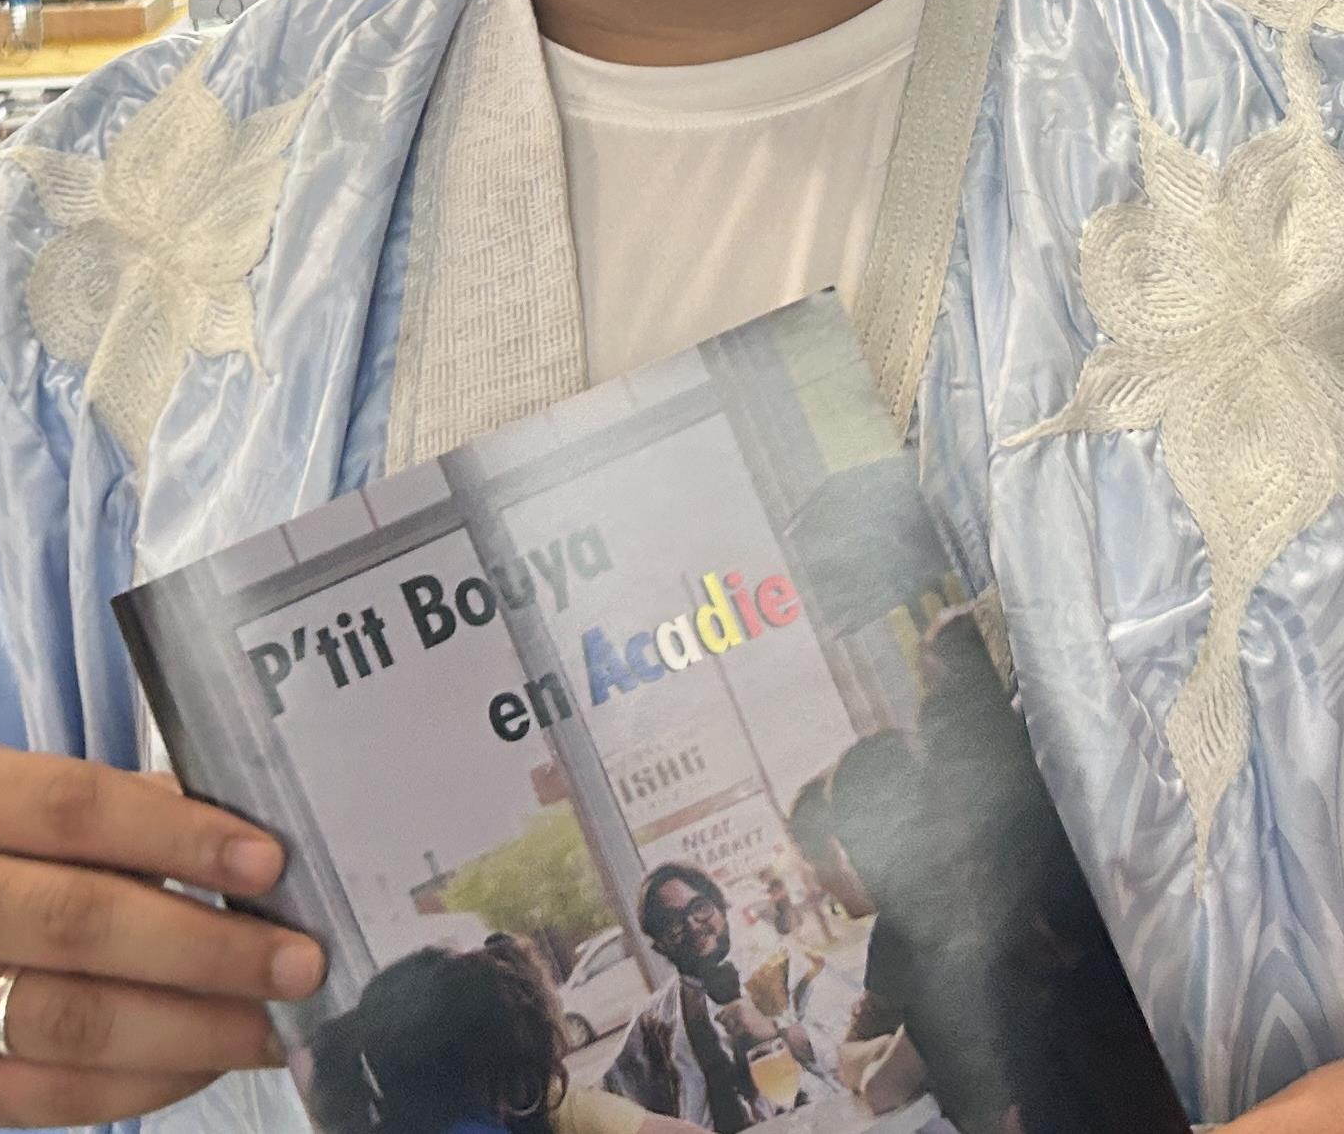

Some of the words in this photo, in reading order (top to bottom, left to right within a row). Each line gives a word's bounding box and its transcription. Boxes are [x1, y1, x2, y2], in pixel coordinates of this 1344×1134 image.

[247, 607, 395, 718] P'tit
[399, 523, 614, 650] Bouya
[488, 672, 574, 742] en
[581, 571, 801, 707] Acadie
